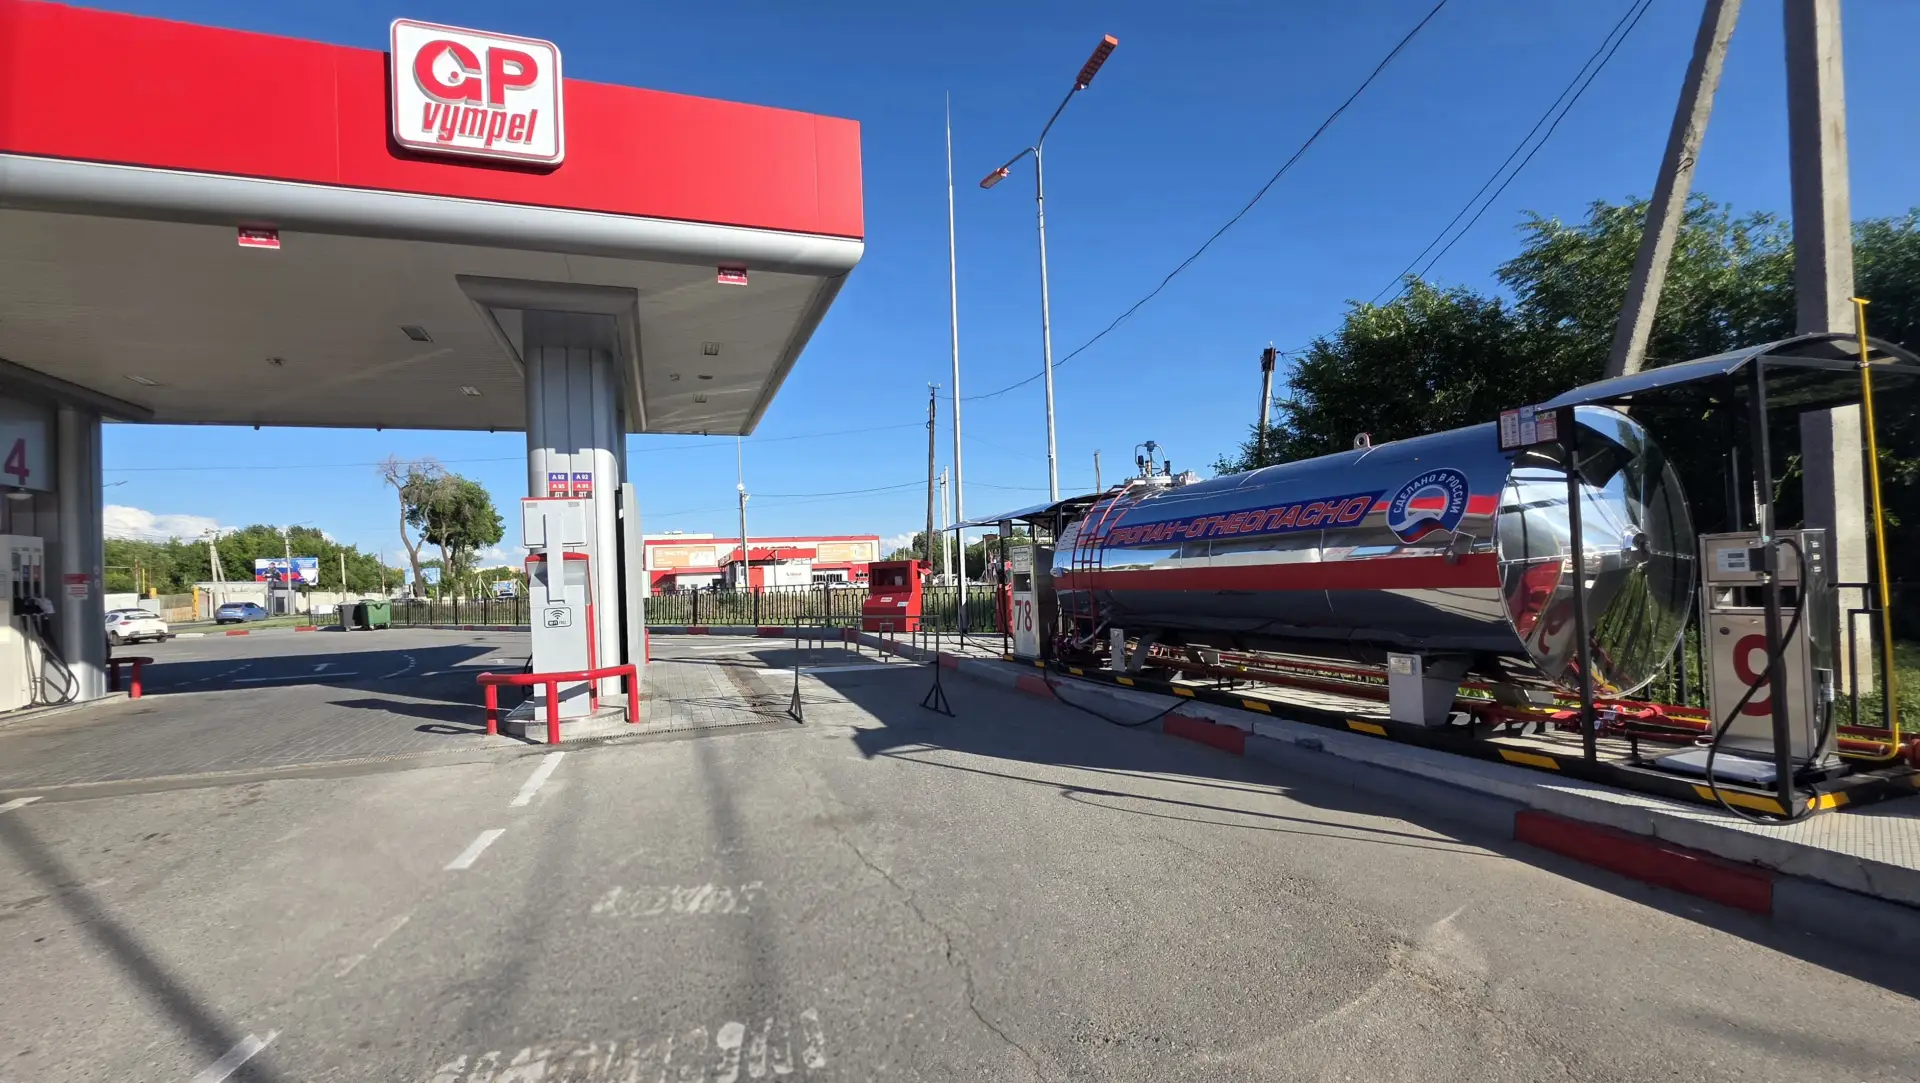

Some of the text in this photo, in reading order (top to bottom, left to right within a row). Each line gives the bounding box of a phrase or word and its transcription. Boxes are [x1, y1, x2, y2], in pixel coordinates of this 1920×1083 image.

[413, 39, 539, 109] GP
[421, 101, 538, 148] vympel
[4, 438, 30, 486] 4
[1393, 473, 1464, 514] СДЕЛАНО В РОССИИ
[1103, 496, 1372, 546] ПРОПАН-ОГНЕОПАСНО
[1732, 633, 1775, 717] 9
